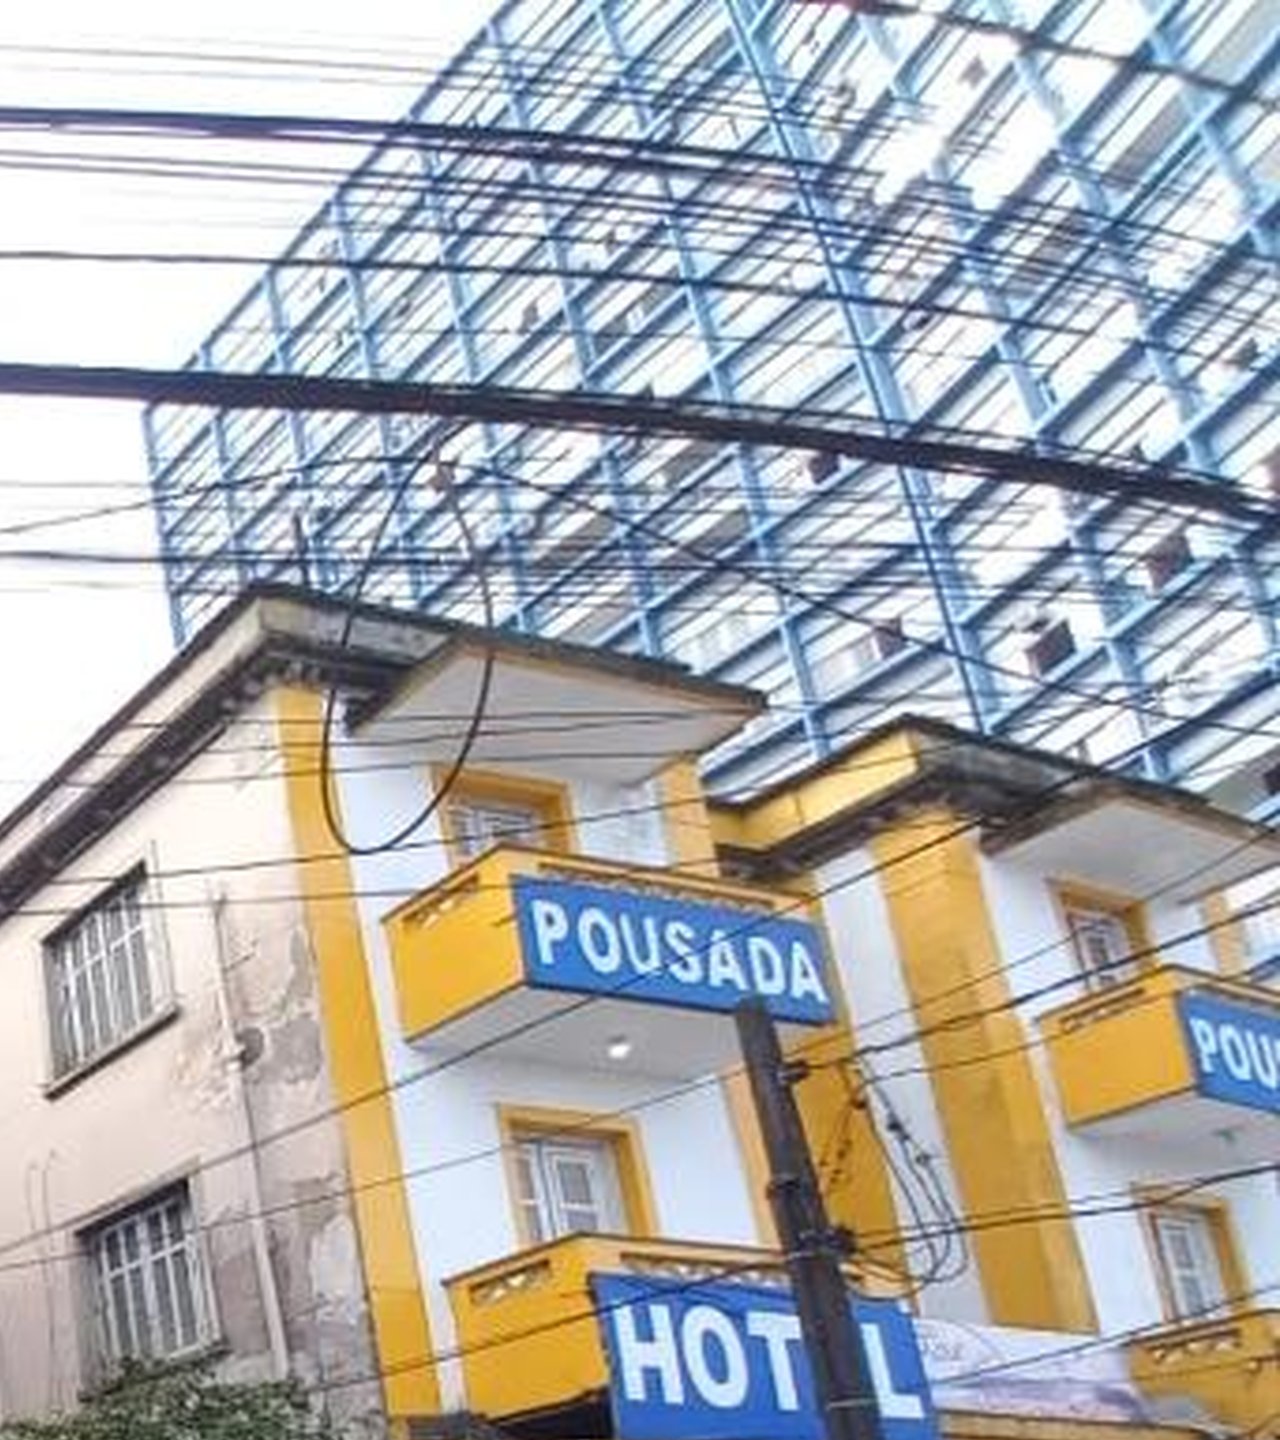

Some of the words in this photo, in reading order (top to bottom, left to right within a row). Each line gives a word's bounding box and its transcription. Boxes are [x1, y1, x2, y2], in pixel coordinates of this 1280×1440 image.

[532, 899, 828, 1003] POUSADA
[1190, 1017, 1280, 1089] POU
[613, 1303, 925, 1419] HOTL
